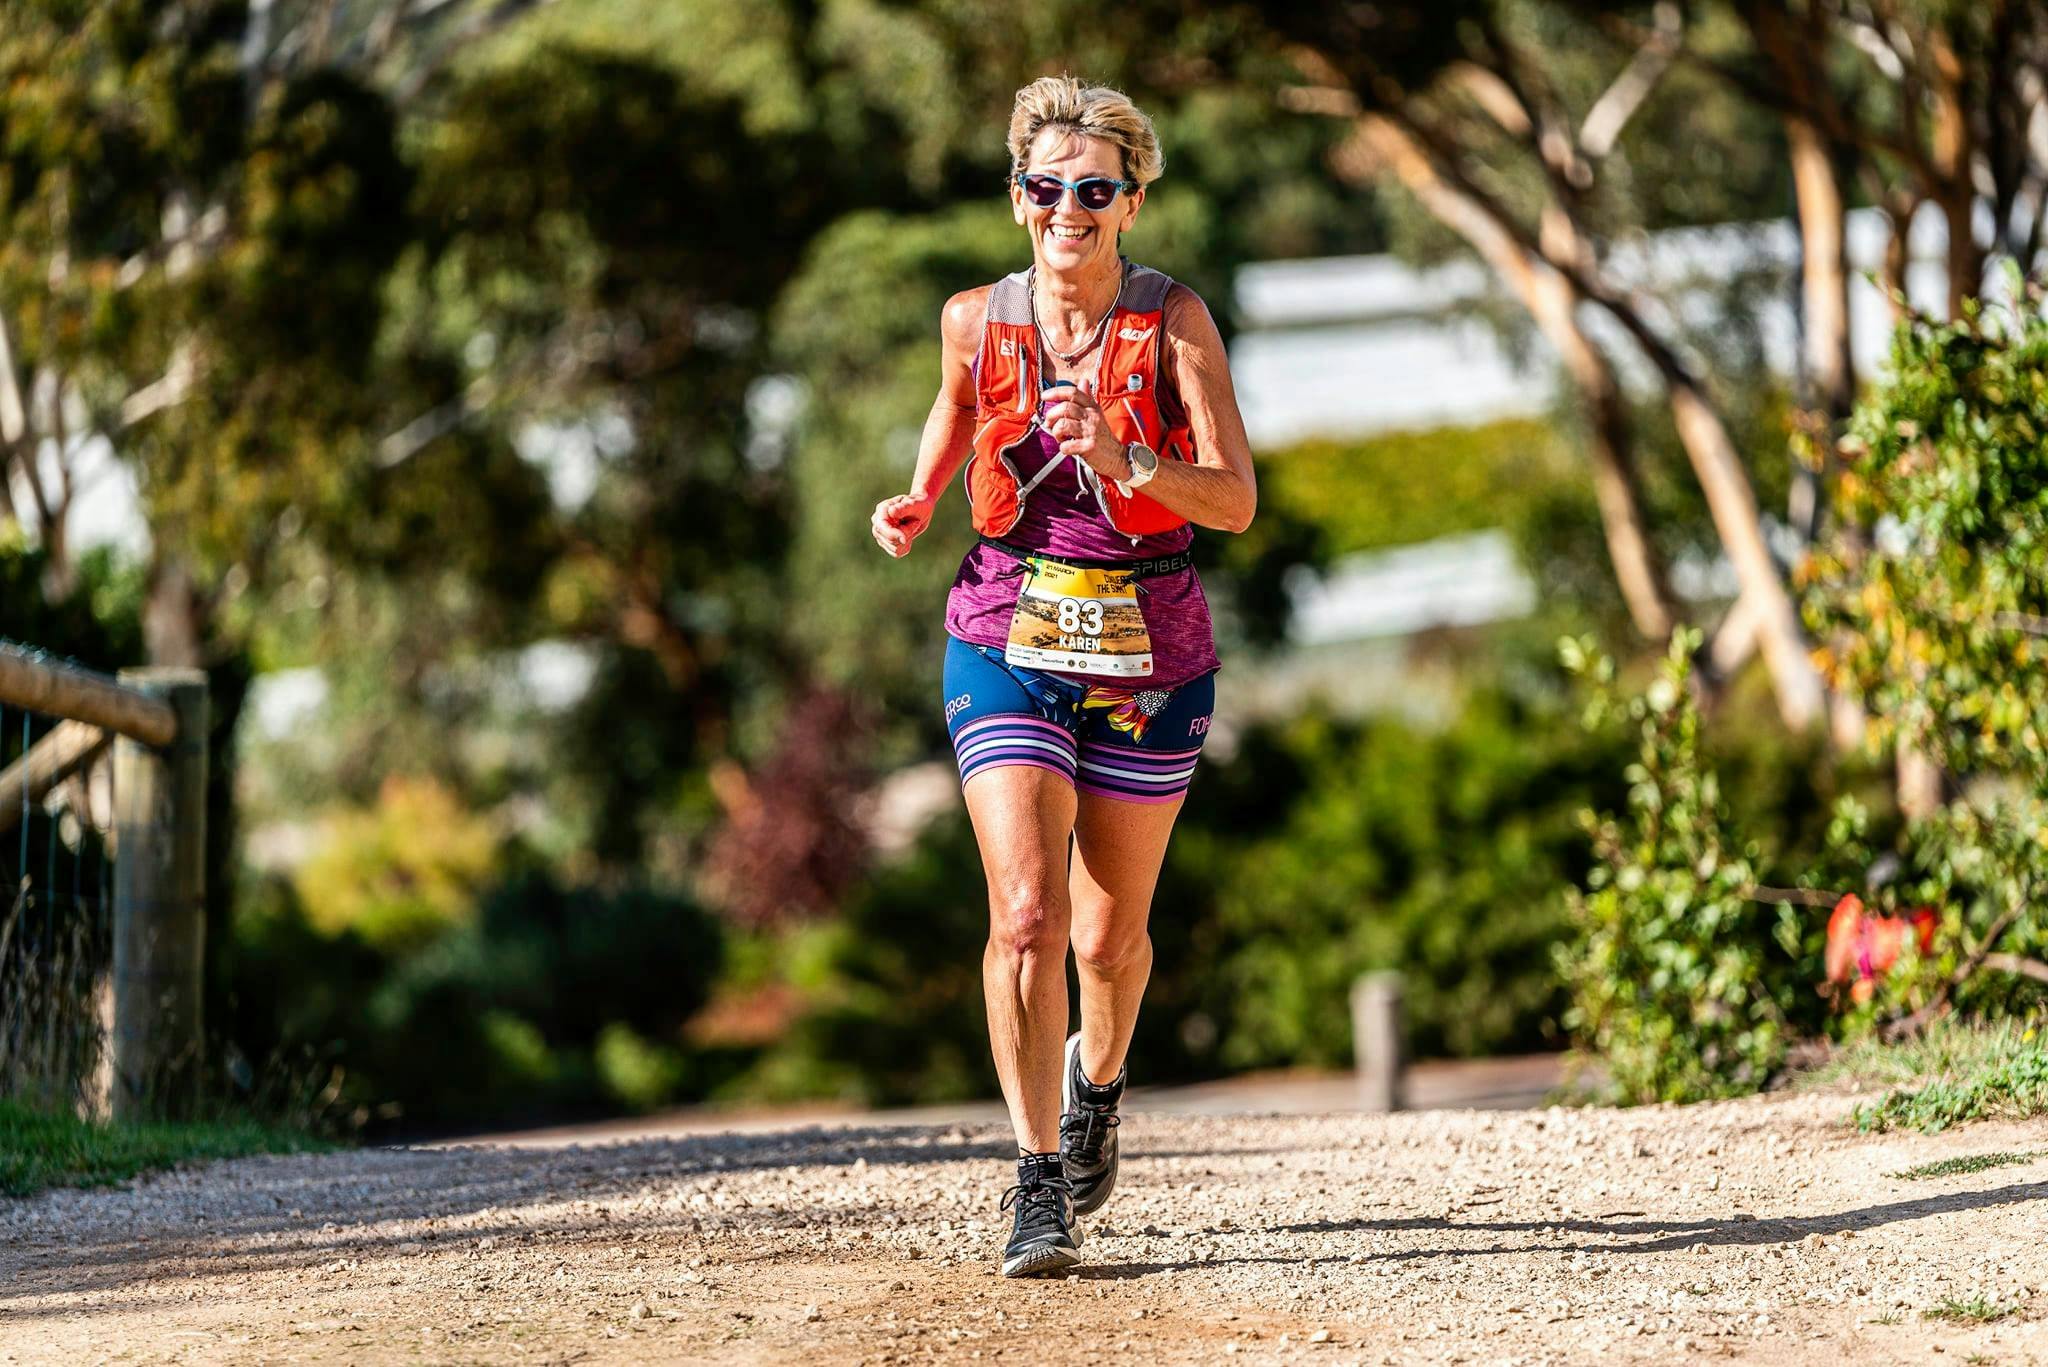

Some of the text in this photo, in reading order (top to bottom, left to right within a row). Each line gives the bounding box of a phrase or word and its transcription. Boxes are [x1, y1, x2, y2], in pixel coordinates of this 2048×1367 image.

[1053, 565, 1076, 576] MARCH
[1097, 584, 1110, 595] THE
[1057, 597, 1104, 636] 83
[1059, 635, 1101, 652] KAREN
